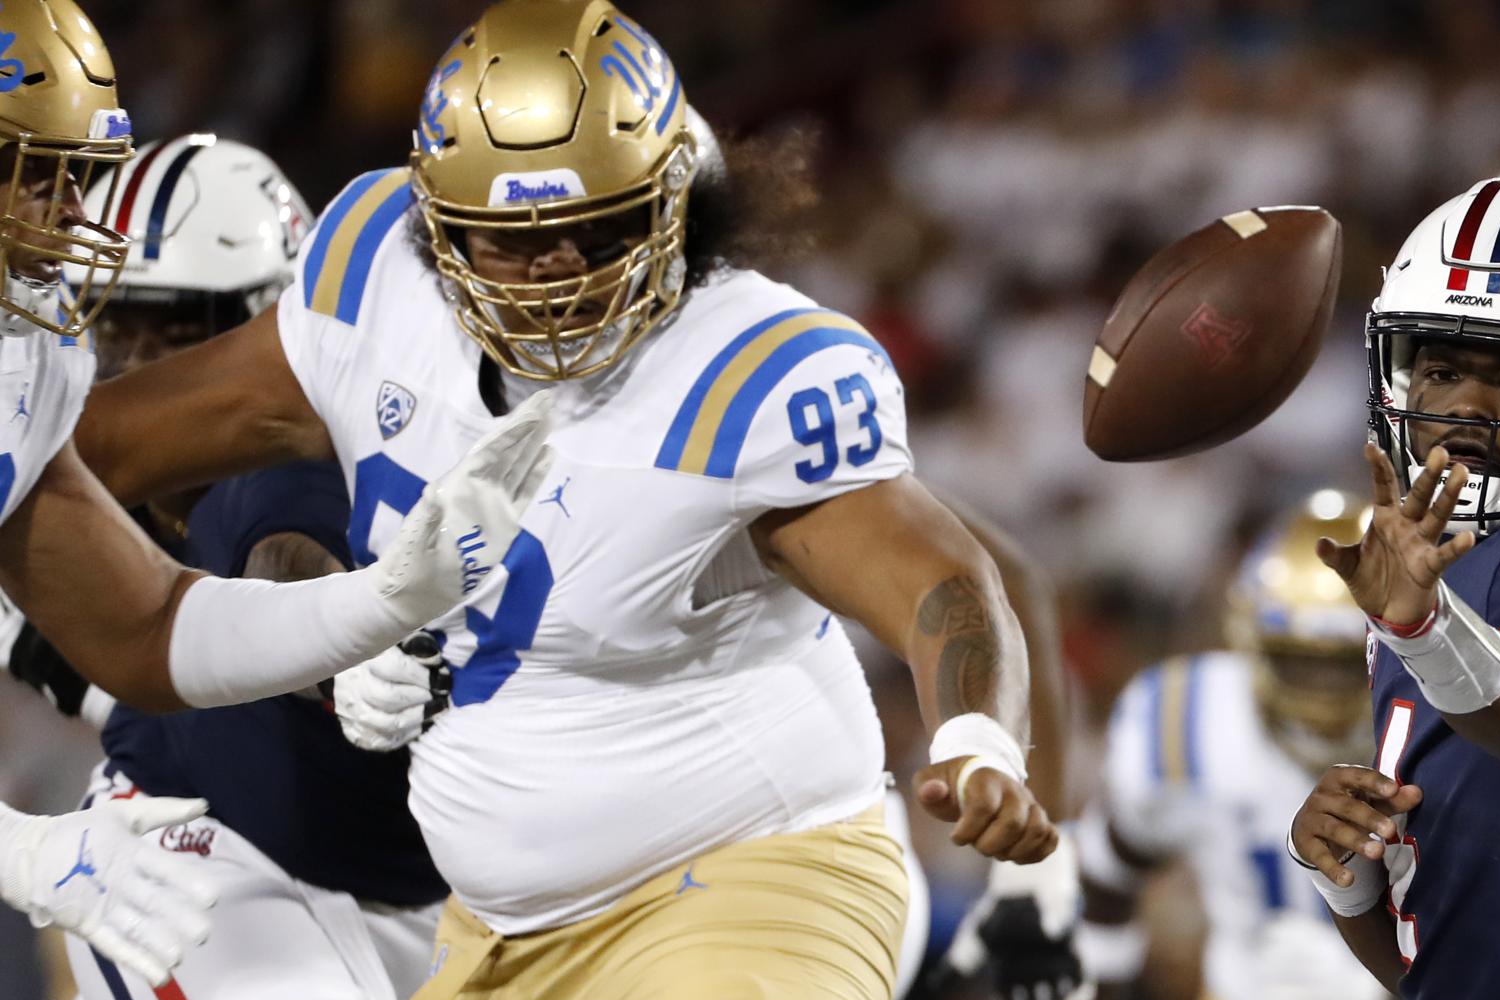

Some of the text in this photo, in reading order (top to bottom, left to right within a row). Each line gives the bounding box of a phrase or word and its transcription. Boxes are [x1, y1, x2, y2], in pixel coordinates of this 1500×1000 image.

[505, 180, 569, 201] Bruins
[1445, 294, 1493, 308] ARIZONA
[786, 372, 883, 485] 93
